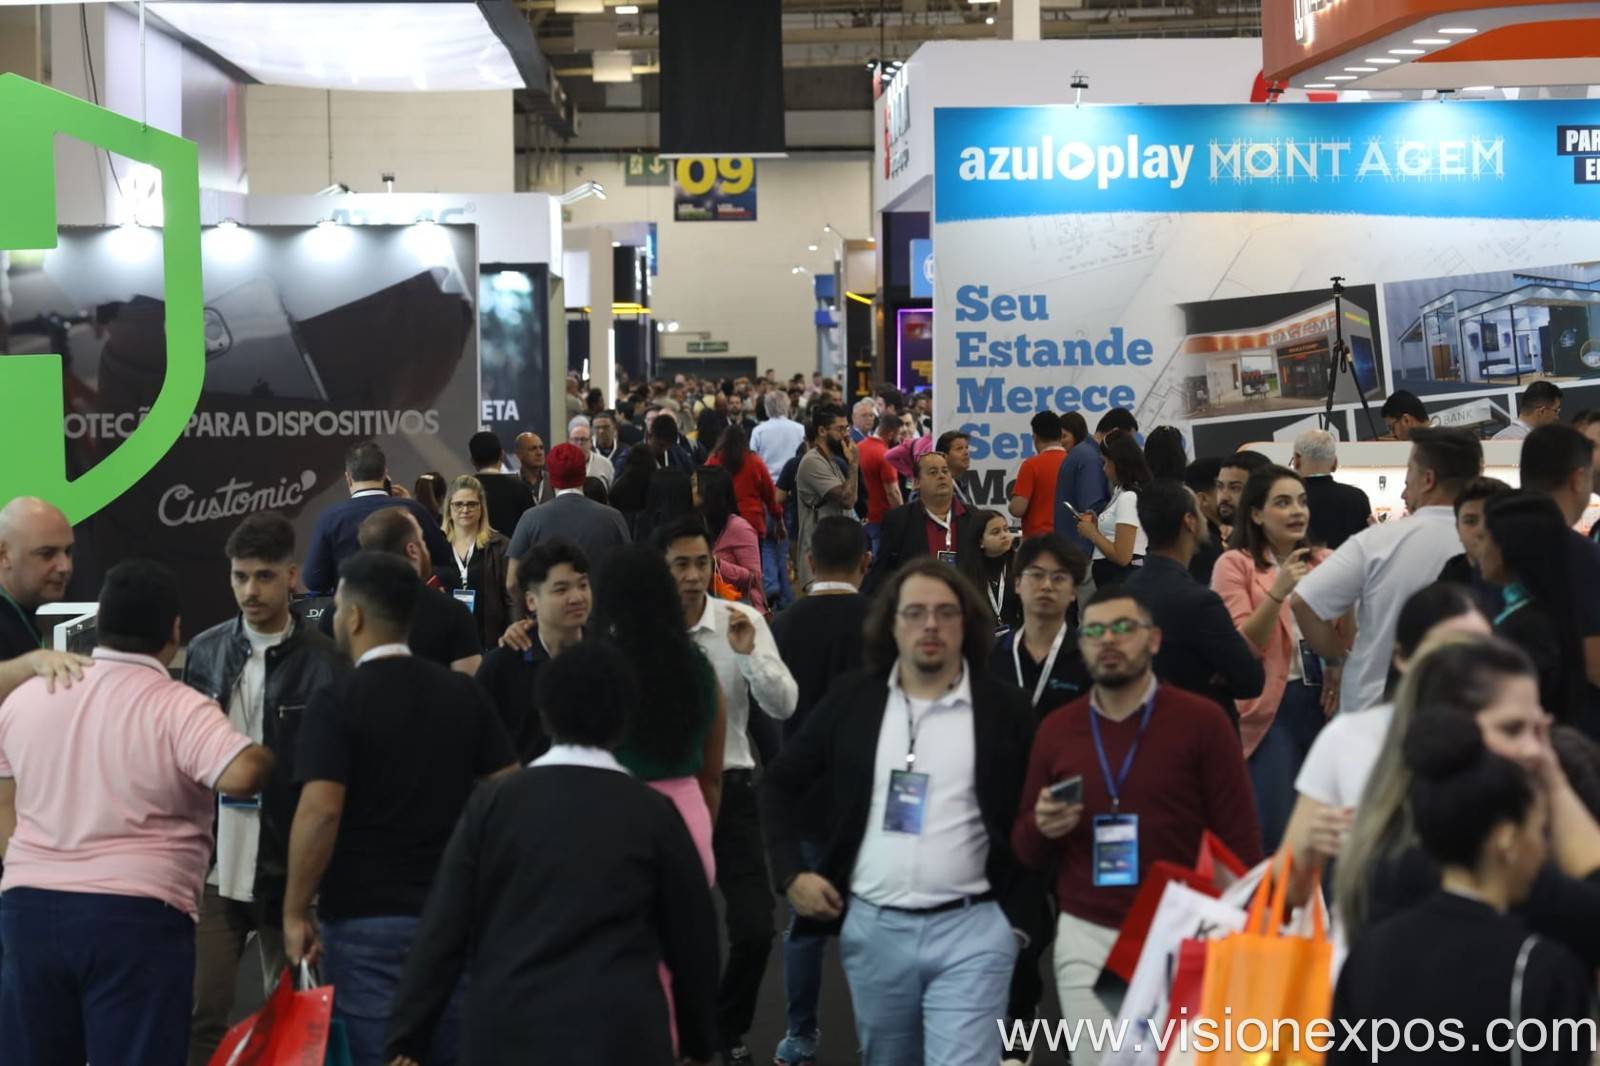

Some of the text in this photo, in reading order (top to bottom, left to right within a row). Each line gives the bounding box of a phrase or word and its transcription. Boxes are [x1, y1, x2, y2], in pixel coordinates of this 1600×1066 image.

[676, 156, 754, 195] 09
[1207, 139, 1504, 181] MONTAGEM
[955, 284, 1049, 322] Seu
[955, 327, 1153, 367] Estande
[956, 377, 1135, 413] Merece
[184, 411, 250, 437] PARA
[256, 409, 439, 436] DISPOSITIVOS
[1444, 407, 1473, 425] BANK
[158, 477, 303, 527] Customic
